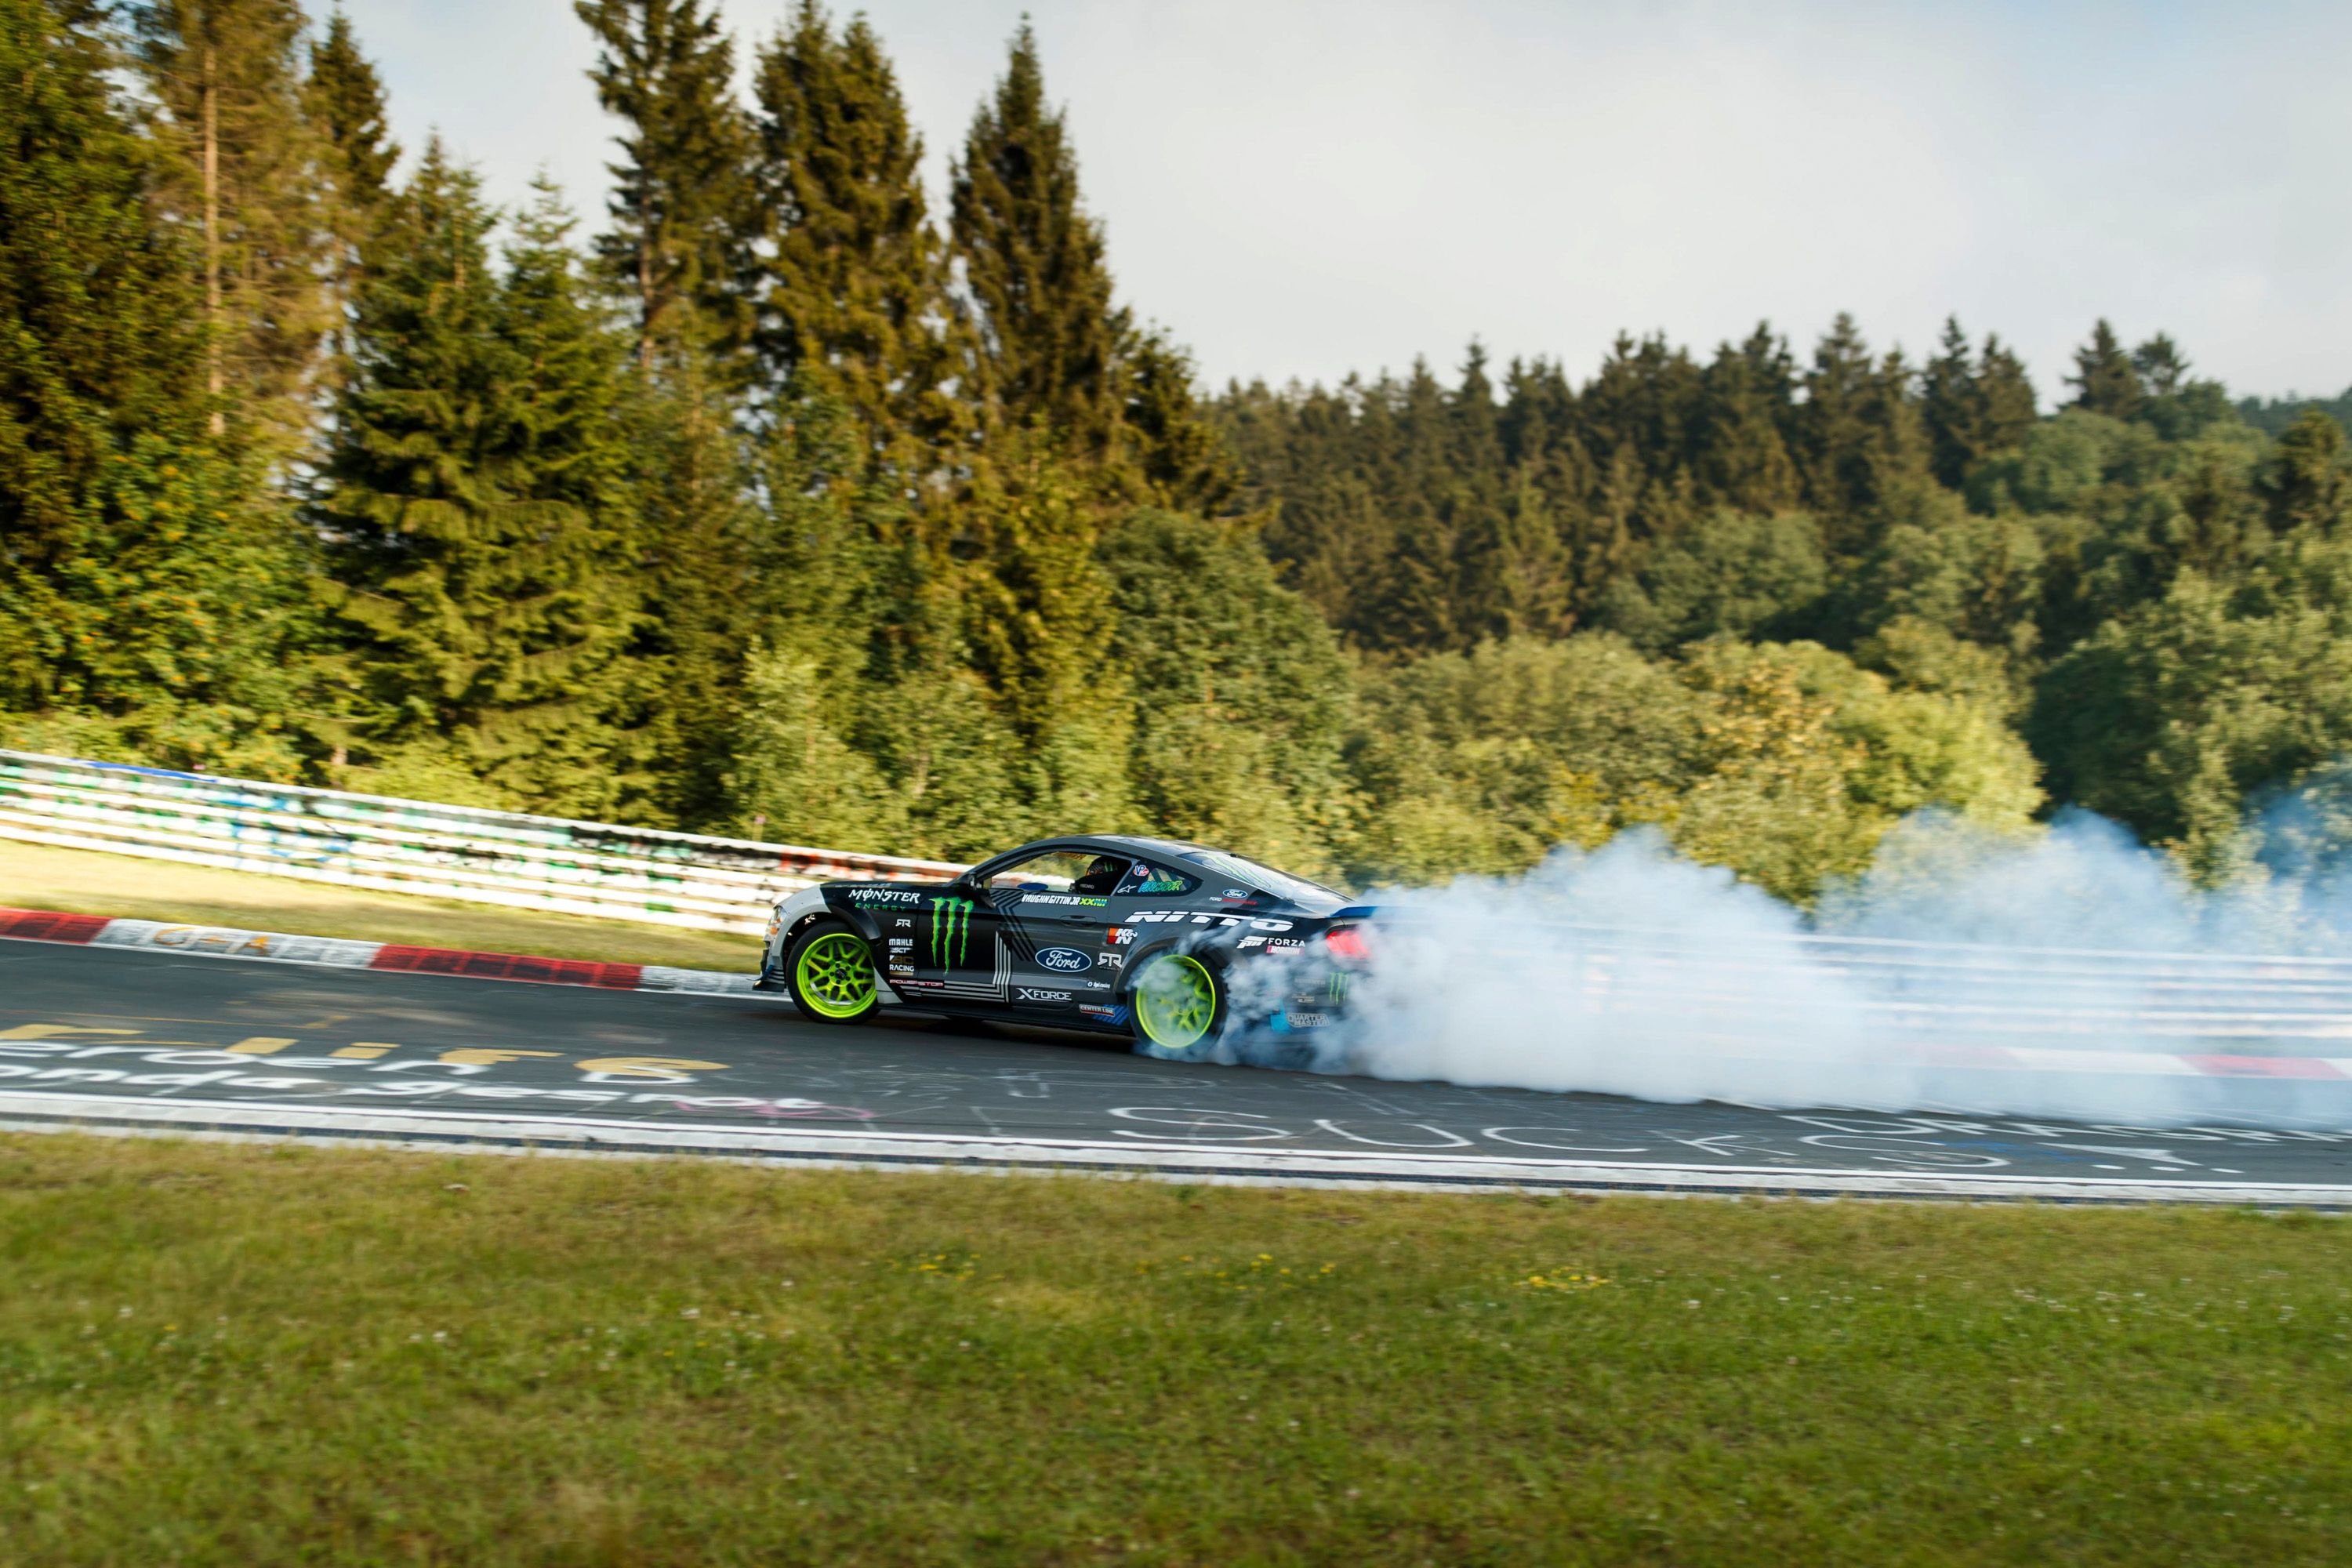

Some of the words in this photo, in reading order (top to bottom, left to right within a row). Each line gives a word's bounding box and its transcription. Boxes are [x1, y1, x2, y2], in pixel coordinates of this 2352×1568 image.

[1022, 894, 1050, 903] VAUGHN
[1048, 895, 1070, 905] GITTIN
[855, 902, 906, 912] ENERGY
[1124, 910, 1294, 932] NITTO
[1269, 938, 1305, 947] FORZA
[1046, 949, 1081, 969] Ford
